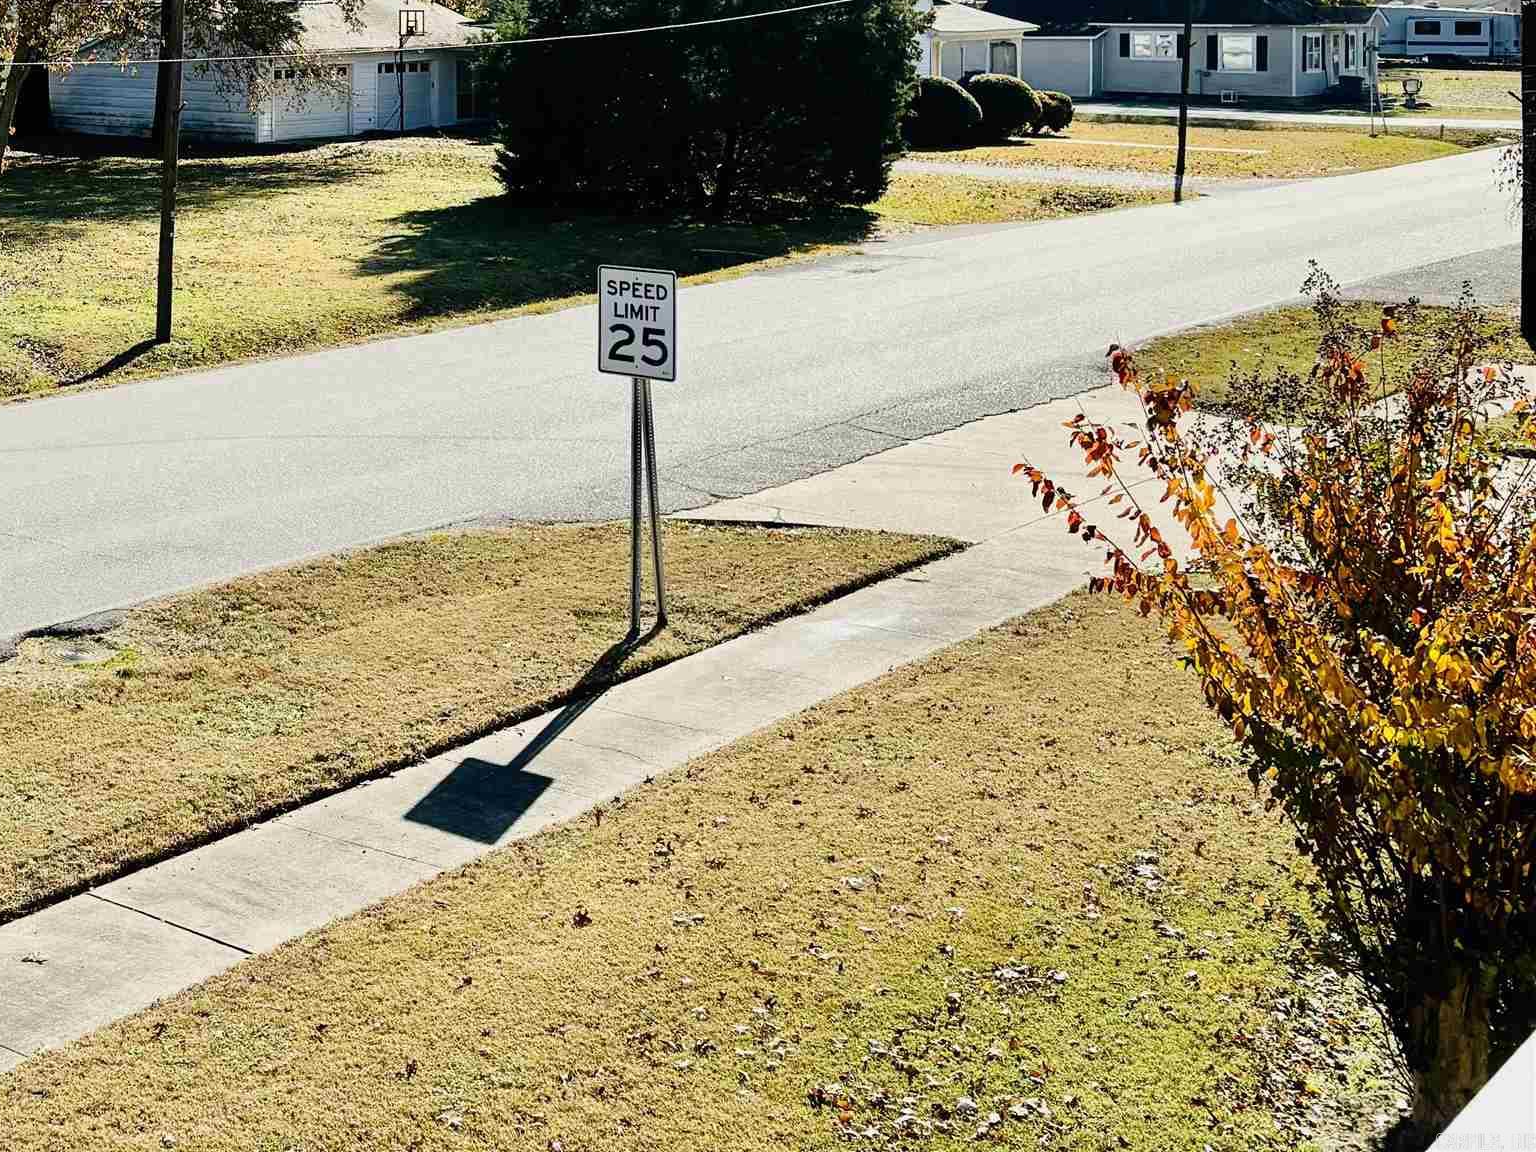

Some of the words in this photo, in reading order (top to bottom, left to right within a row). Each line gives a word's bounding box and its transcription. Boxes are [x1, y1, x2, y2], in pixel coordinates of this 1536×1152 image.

[607, 280, 668, 301] SPEED
[614, 302, 661, 322] LIMIT
[607, 323, 668, 367] 25
